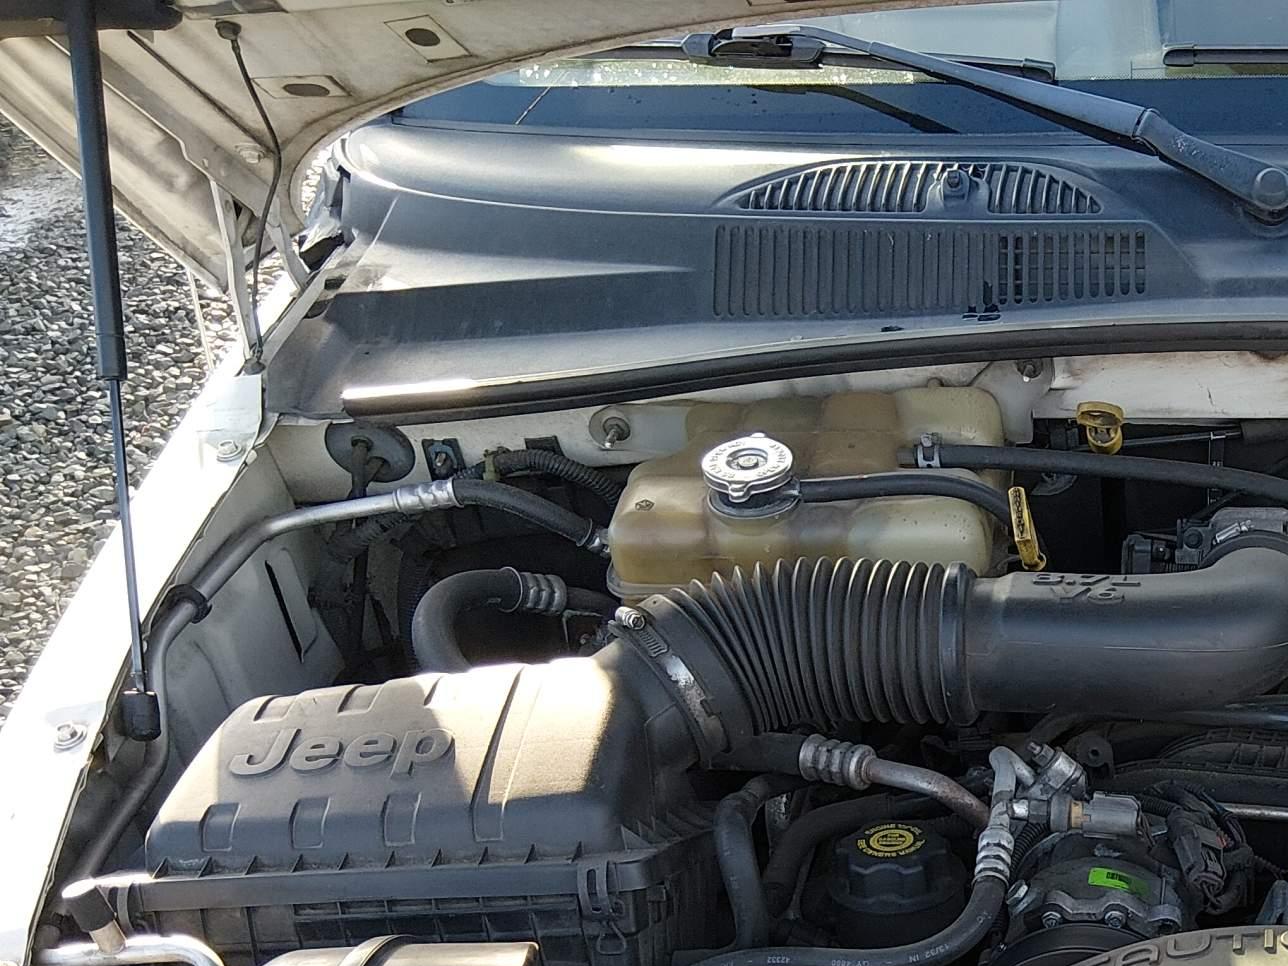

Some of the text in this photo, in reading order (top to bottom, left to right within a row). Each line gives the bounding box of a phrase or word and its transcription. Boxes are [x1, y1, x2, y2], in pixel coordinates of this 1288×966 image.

[1050, 586, 1125, 604] V6
[229, 728, 456, 780] Jeep
[909, 955, 920, 963] IN
